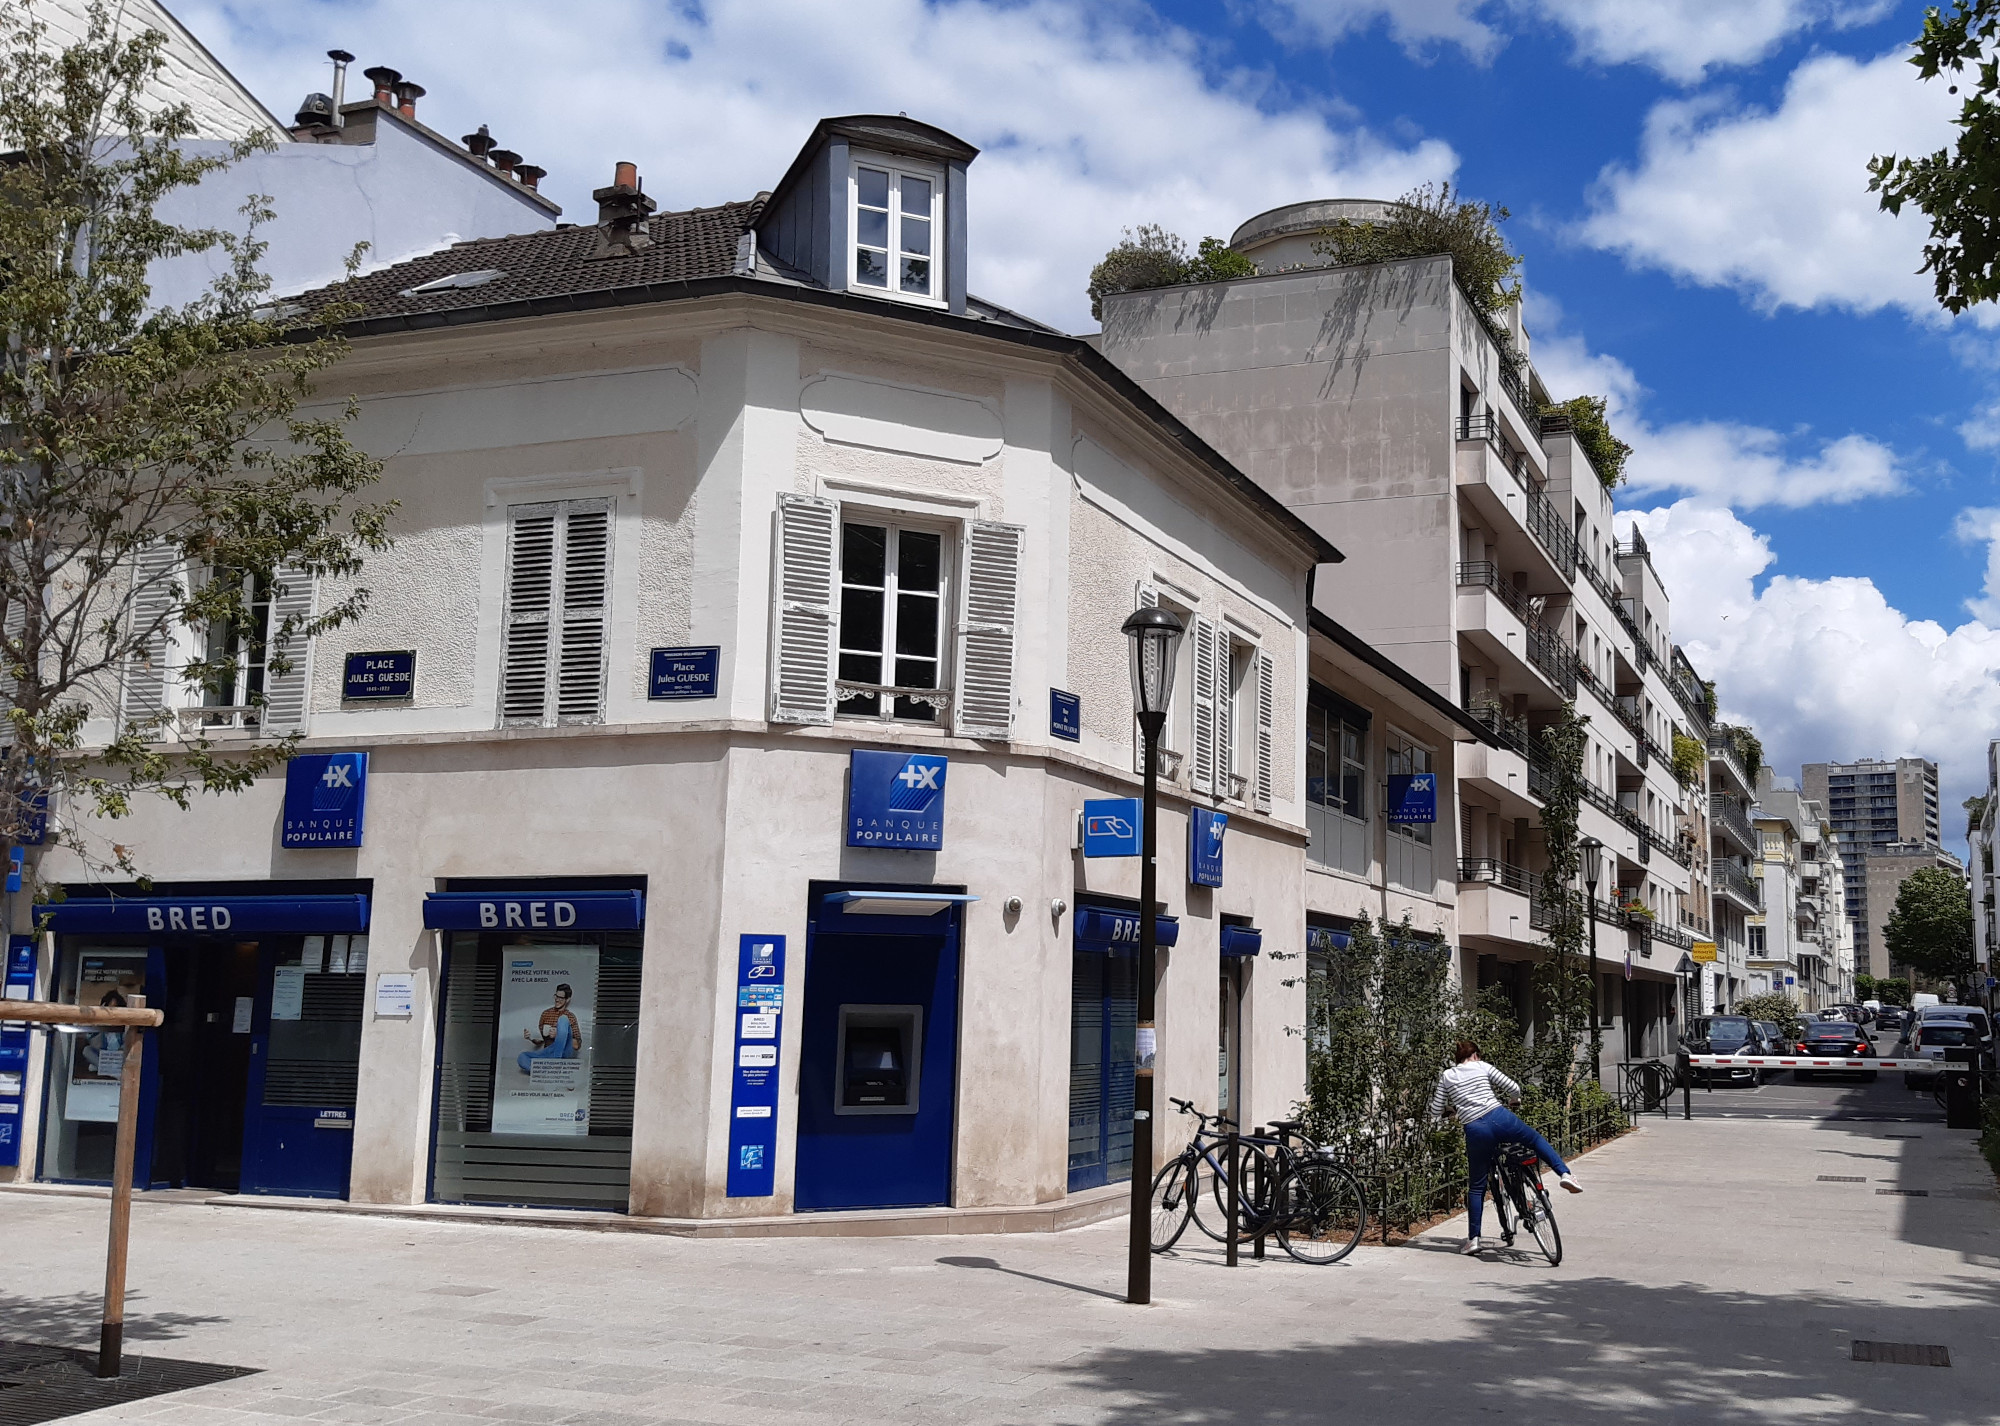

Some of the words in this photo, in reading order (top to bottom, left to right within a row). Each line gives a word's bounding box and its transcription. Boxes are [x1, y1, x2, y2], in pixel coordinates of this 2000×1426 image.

[366, 660, 395, 669] PLACE
[673, 663, 695, 671] Place
[348, 673, 374, 683] JULES
[378, 672, 411, 682] GUESDE
[657, 674, 676, 685] Jules
[677, 673, 710, 682] GUESDE
[287, 818, 354, 829] BANQUE
[857, 817, 939, 830] BANQUE
[286, 831, 353, 842] POPULAIRE
[856, 831, 938, 843] POPULAIRE
[1198, 872, 1222, 882] POPULAIRE
[147, 906, 231, 930] BRED
[480, 902, 576, 927] BRED
[1111, 918, 1141, 942] BRE
[320, 1110, 347, 1118] LETTRES
